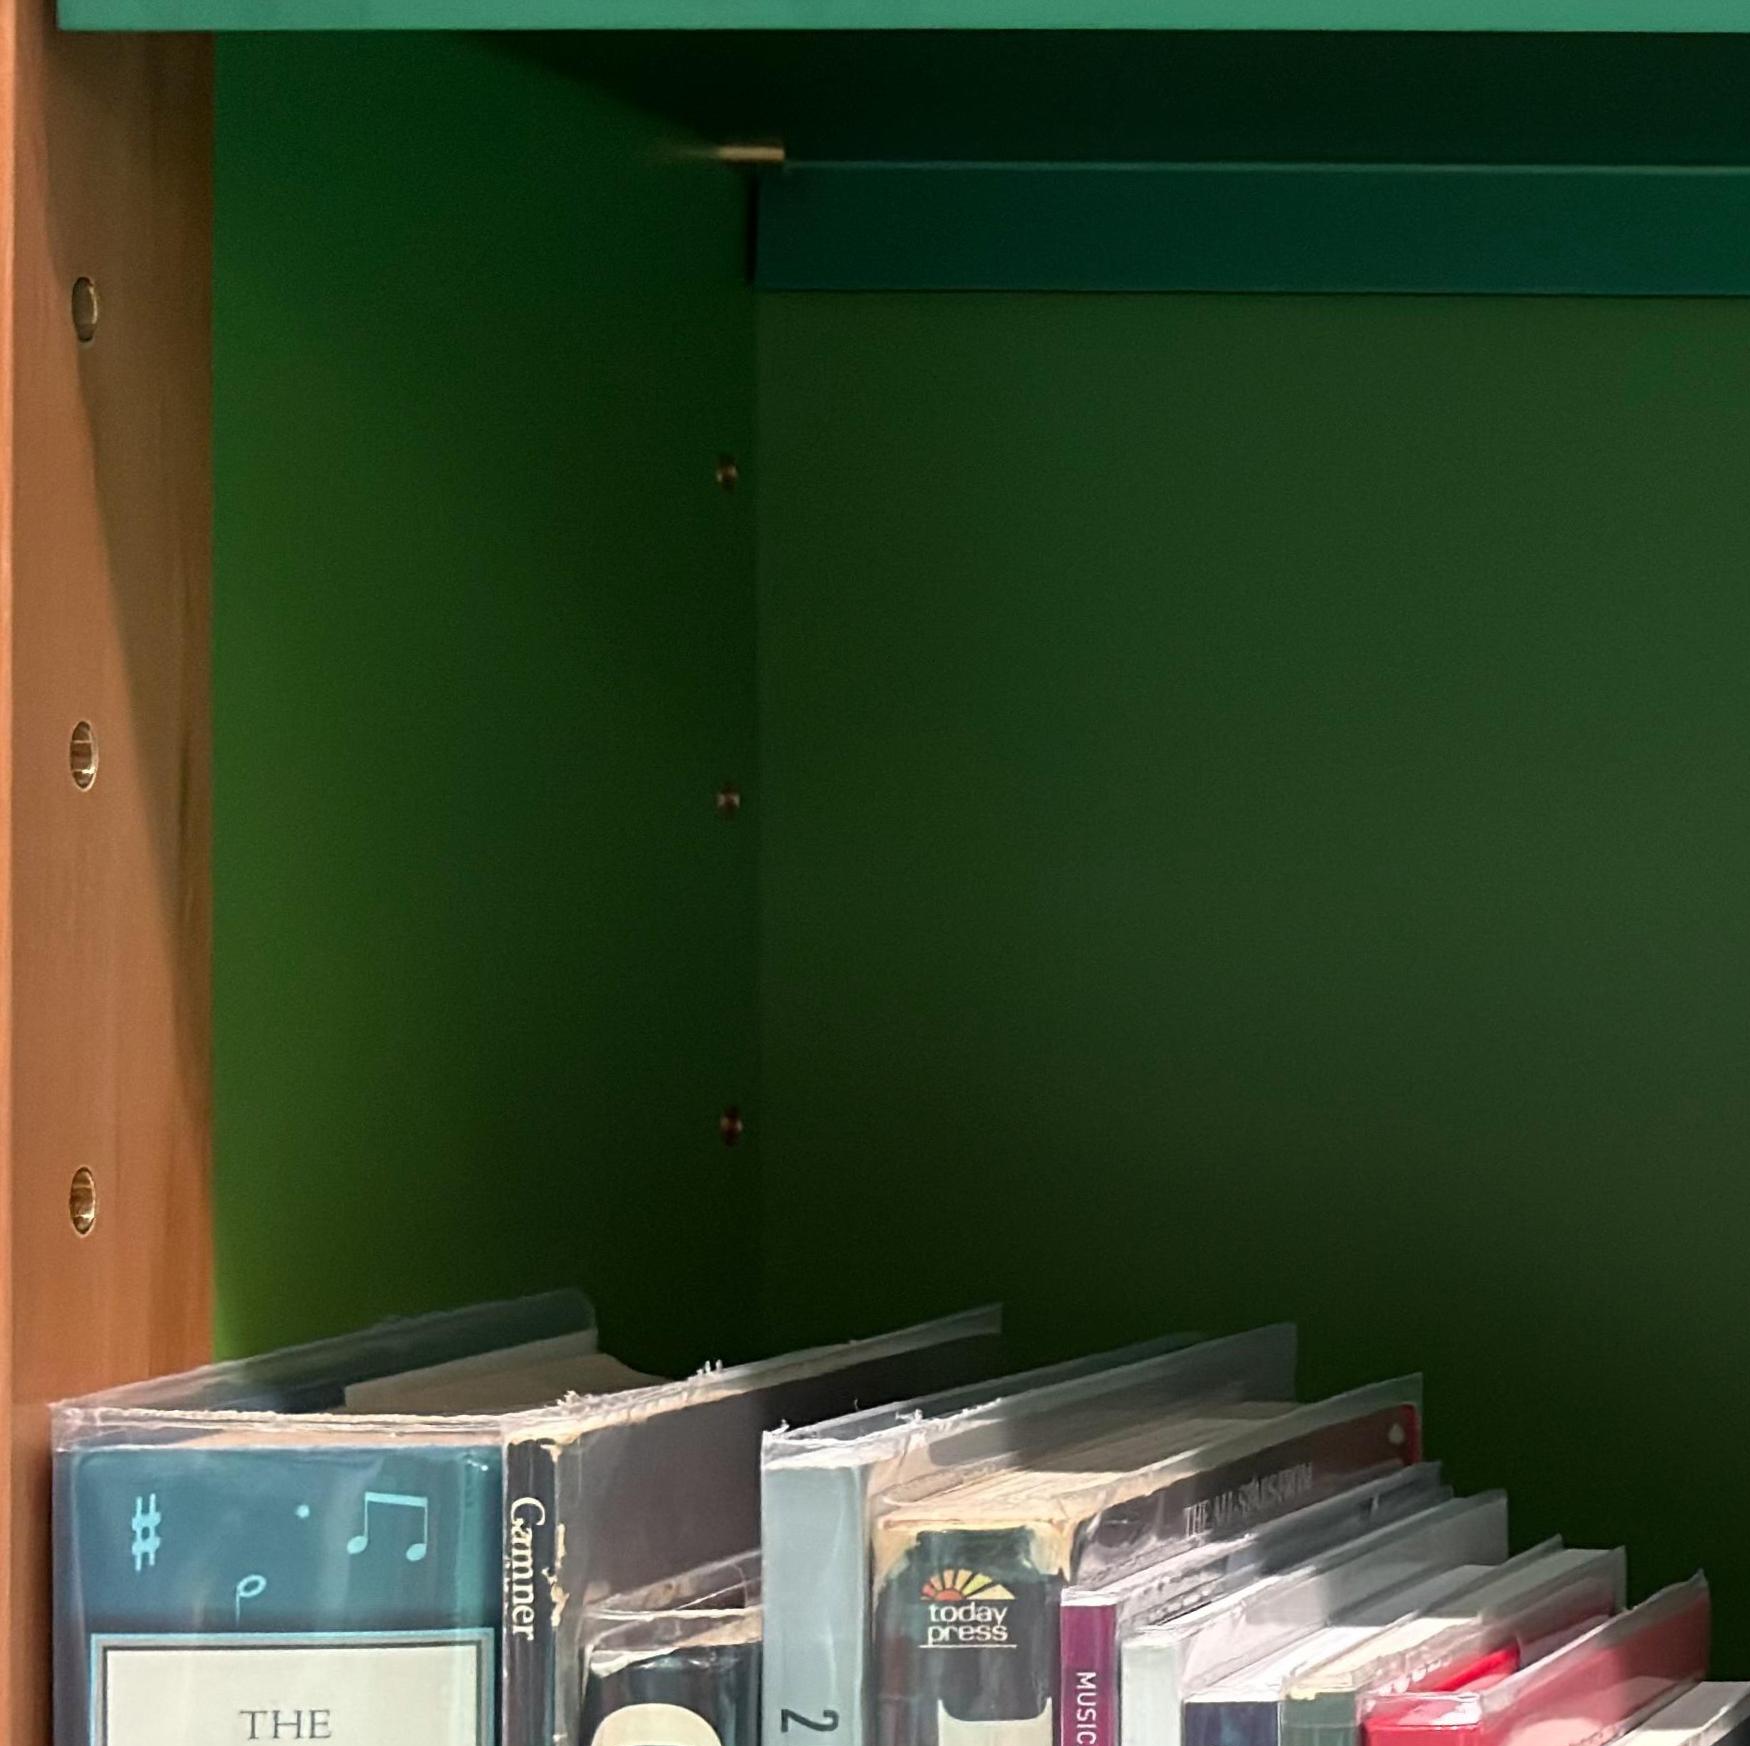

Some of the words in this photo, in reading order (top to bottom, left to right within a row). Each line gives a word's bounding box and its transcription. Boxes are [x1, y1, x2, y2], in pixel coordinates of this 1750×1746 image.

[928, 1601, 1008, 1625] today
[928, 1624, 1008, 1646] press
[239, 1709, 332, 1740] THE
